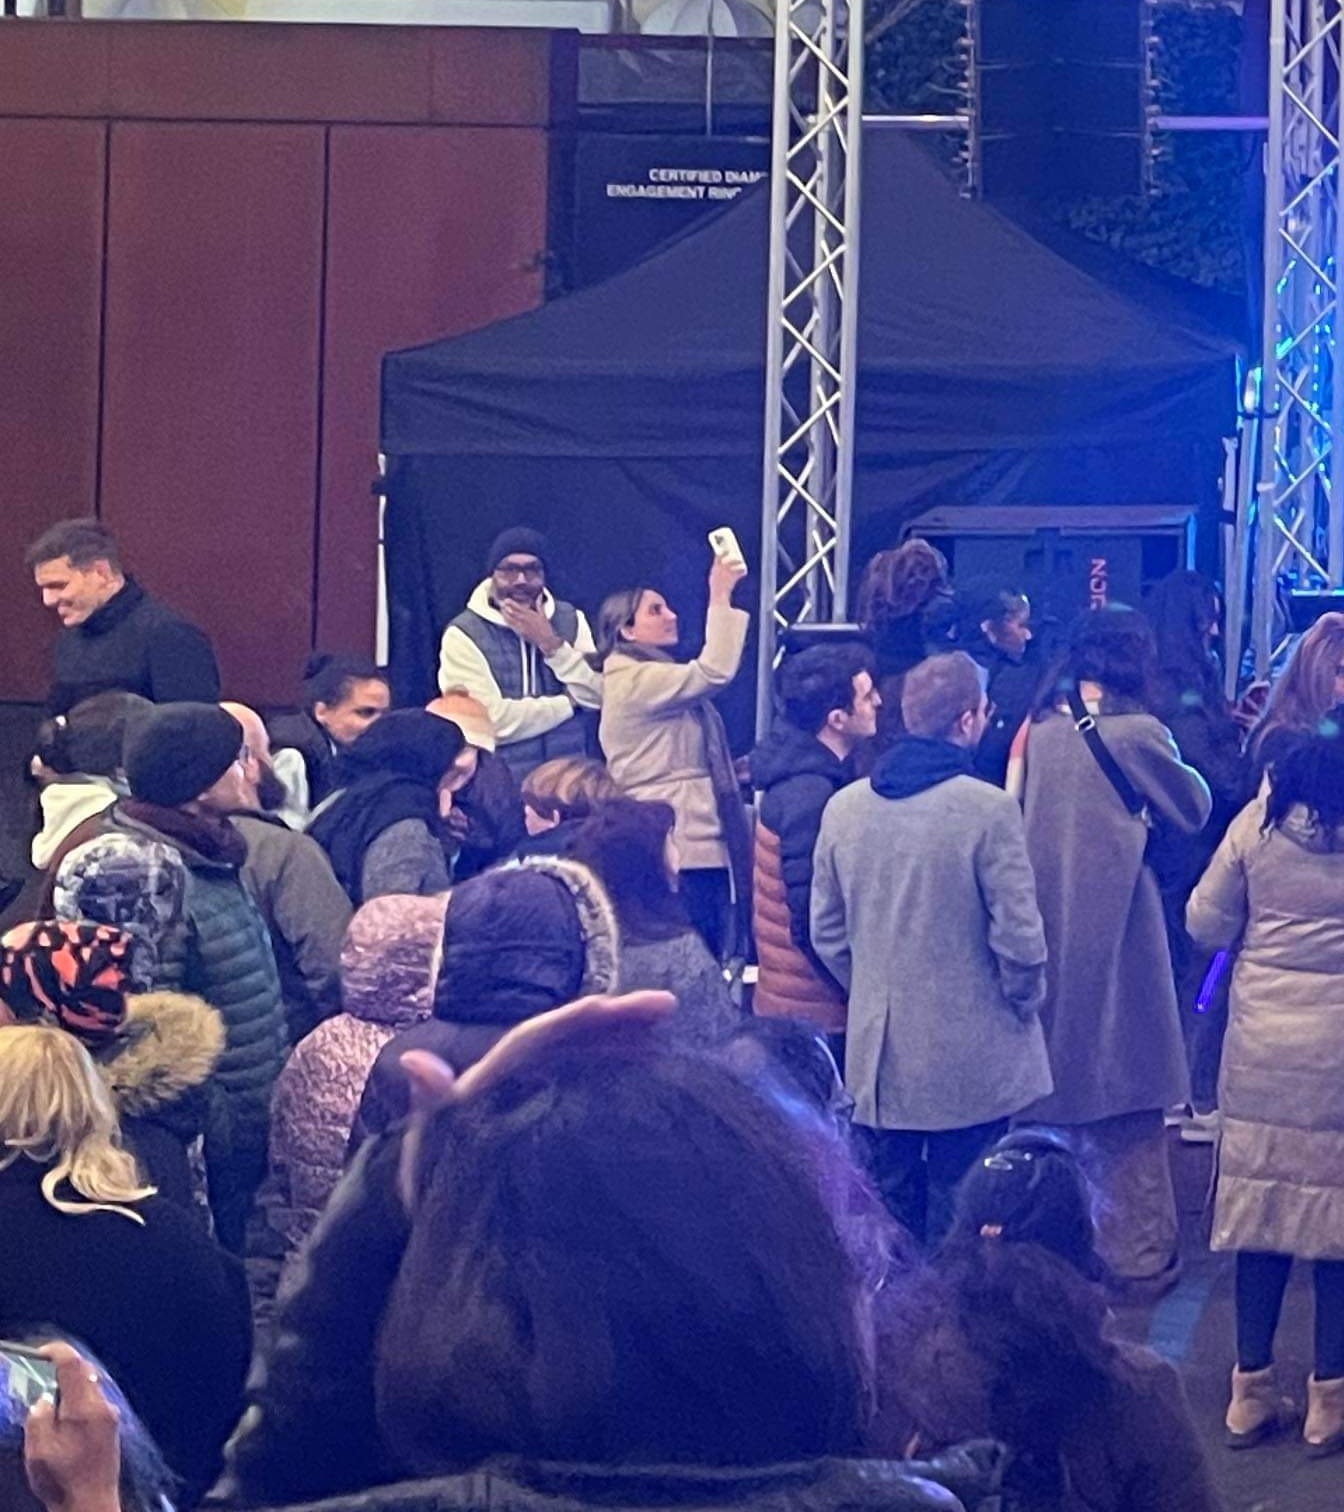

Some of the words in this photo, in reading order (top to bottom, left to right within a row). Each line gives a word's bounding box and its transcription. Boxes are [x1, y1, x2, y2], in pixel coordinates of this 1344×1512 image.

[649, 168, 722, 182] CERTIFIED
[725, 171, 768, 183] DIAM
[607, 184, 705, 198] ENGAGEMENT
